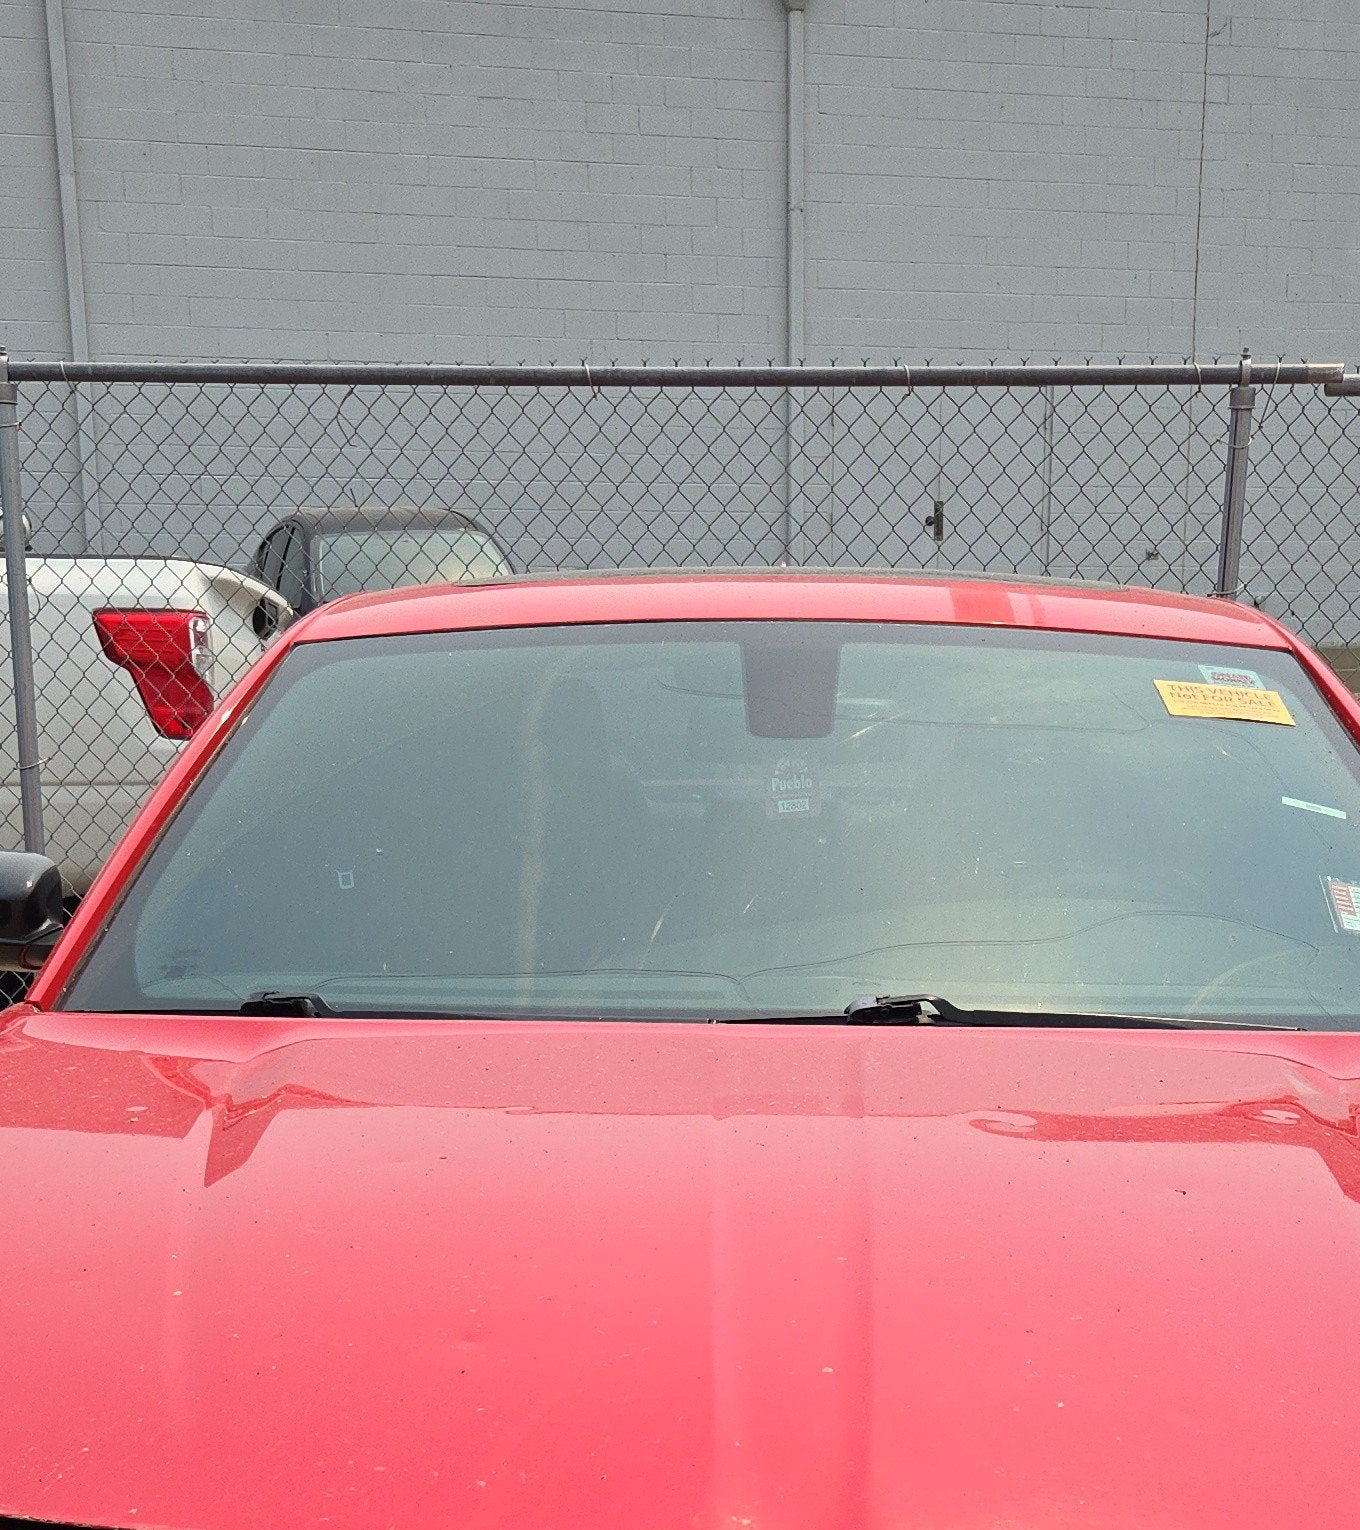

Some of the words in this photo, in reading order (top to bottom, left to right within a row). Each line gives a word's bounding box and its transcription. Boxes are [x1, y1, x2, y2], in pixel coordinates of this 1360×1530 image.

[1166, 684, 1204, 694] THIS
[1208, 687, 1272, 700] VEHICLE
[1237, 697, 1274, 707] SALE
[771, 774, 813, 791] Pueblo
